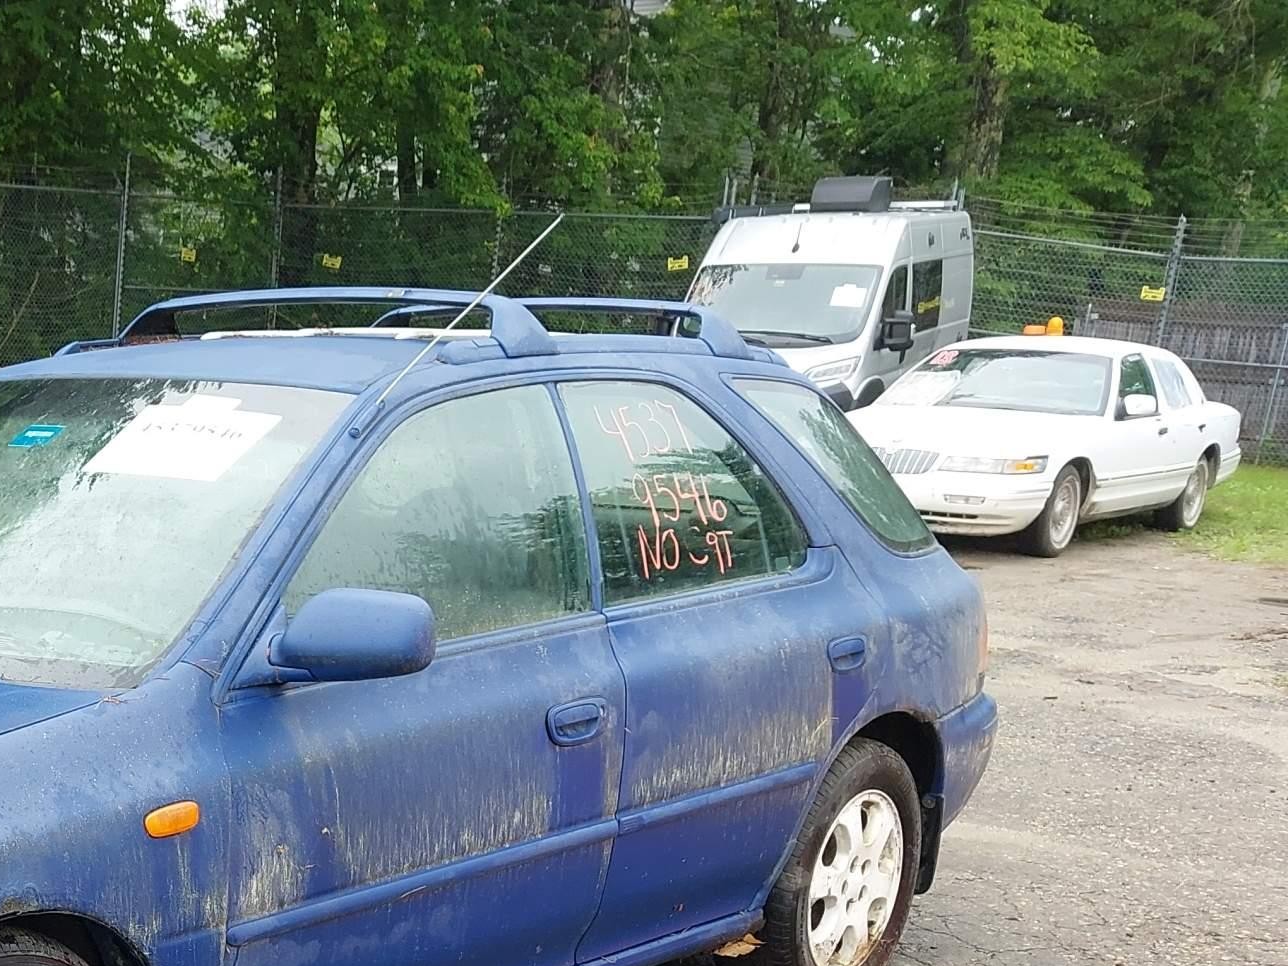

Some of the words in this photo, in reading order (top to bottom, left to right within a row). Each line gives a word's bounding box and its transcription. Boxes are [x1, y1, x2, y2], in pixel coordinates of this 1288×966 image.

[594, 400, 693, 462] 4537
[632, 472, 728, 527] 9546
[638, 525, 680, 579] NO
